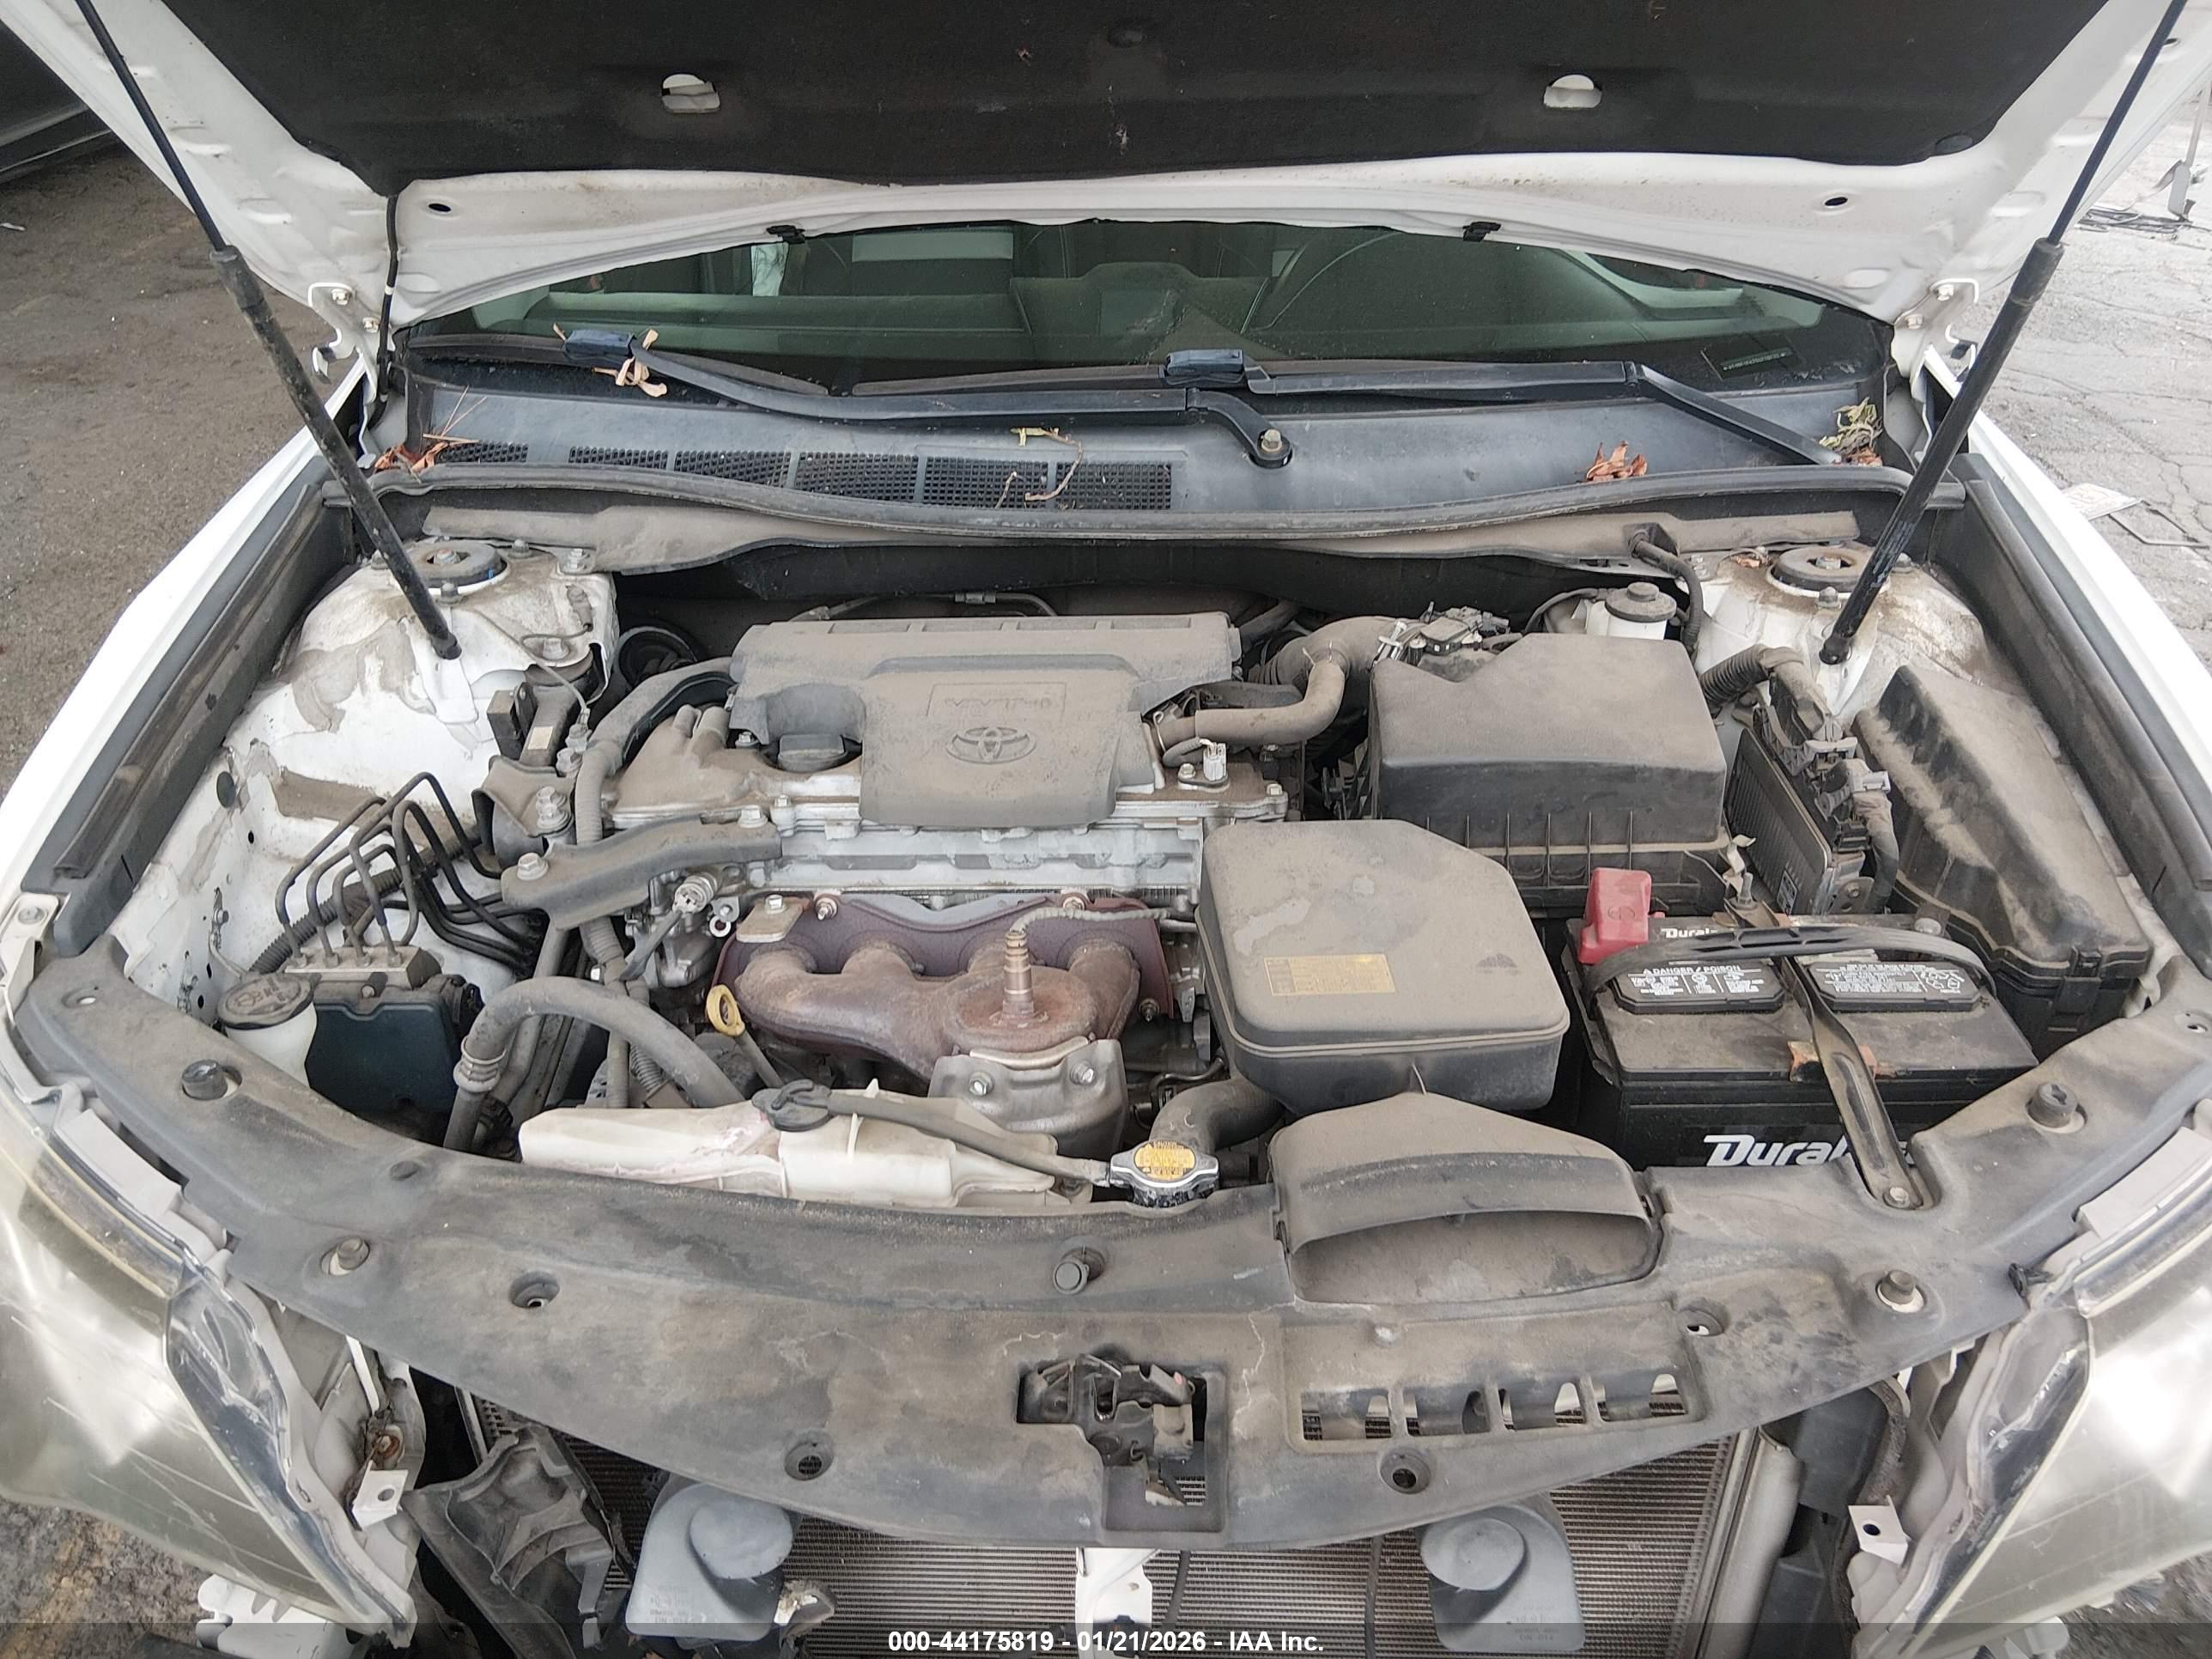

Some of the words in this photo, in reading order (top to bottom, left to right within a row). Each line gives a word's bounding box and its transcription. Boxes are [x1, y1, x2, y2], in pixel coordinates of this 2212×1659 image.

[1661, 927, 1718, 939] Dural
[1652, 966, 1693, 975] DANGER
[1703, 964, 1741, 973] POISON
[1704, 1134, 1915, 1166] Dural
